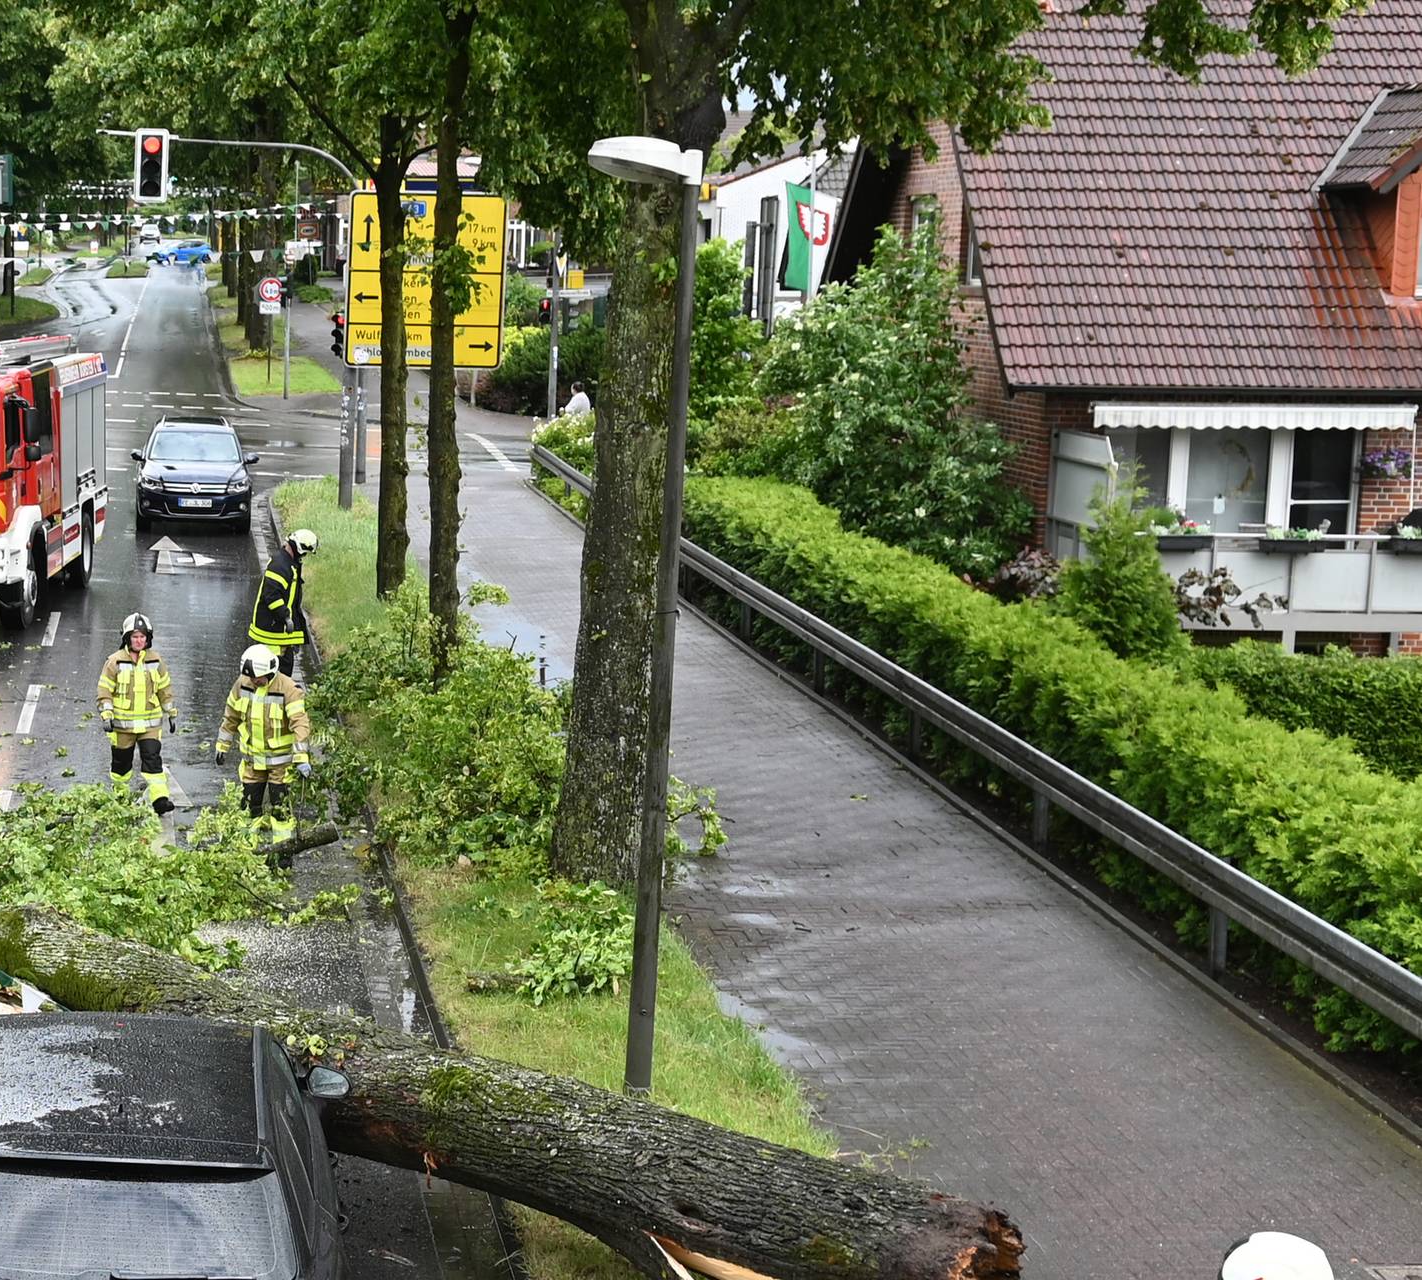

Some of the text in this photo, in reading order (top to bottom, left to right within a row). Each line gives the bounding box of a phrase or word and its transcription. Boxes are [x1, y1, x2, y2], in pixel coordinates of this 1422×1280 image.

[469, 224, 496, 233] 17 km
[473, 239, 478, 247] 9
[355, 330, 381, 340] Wulf
